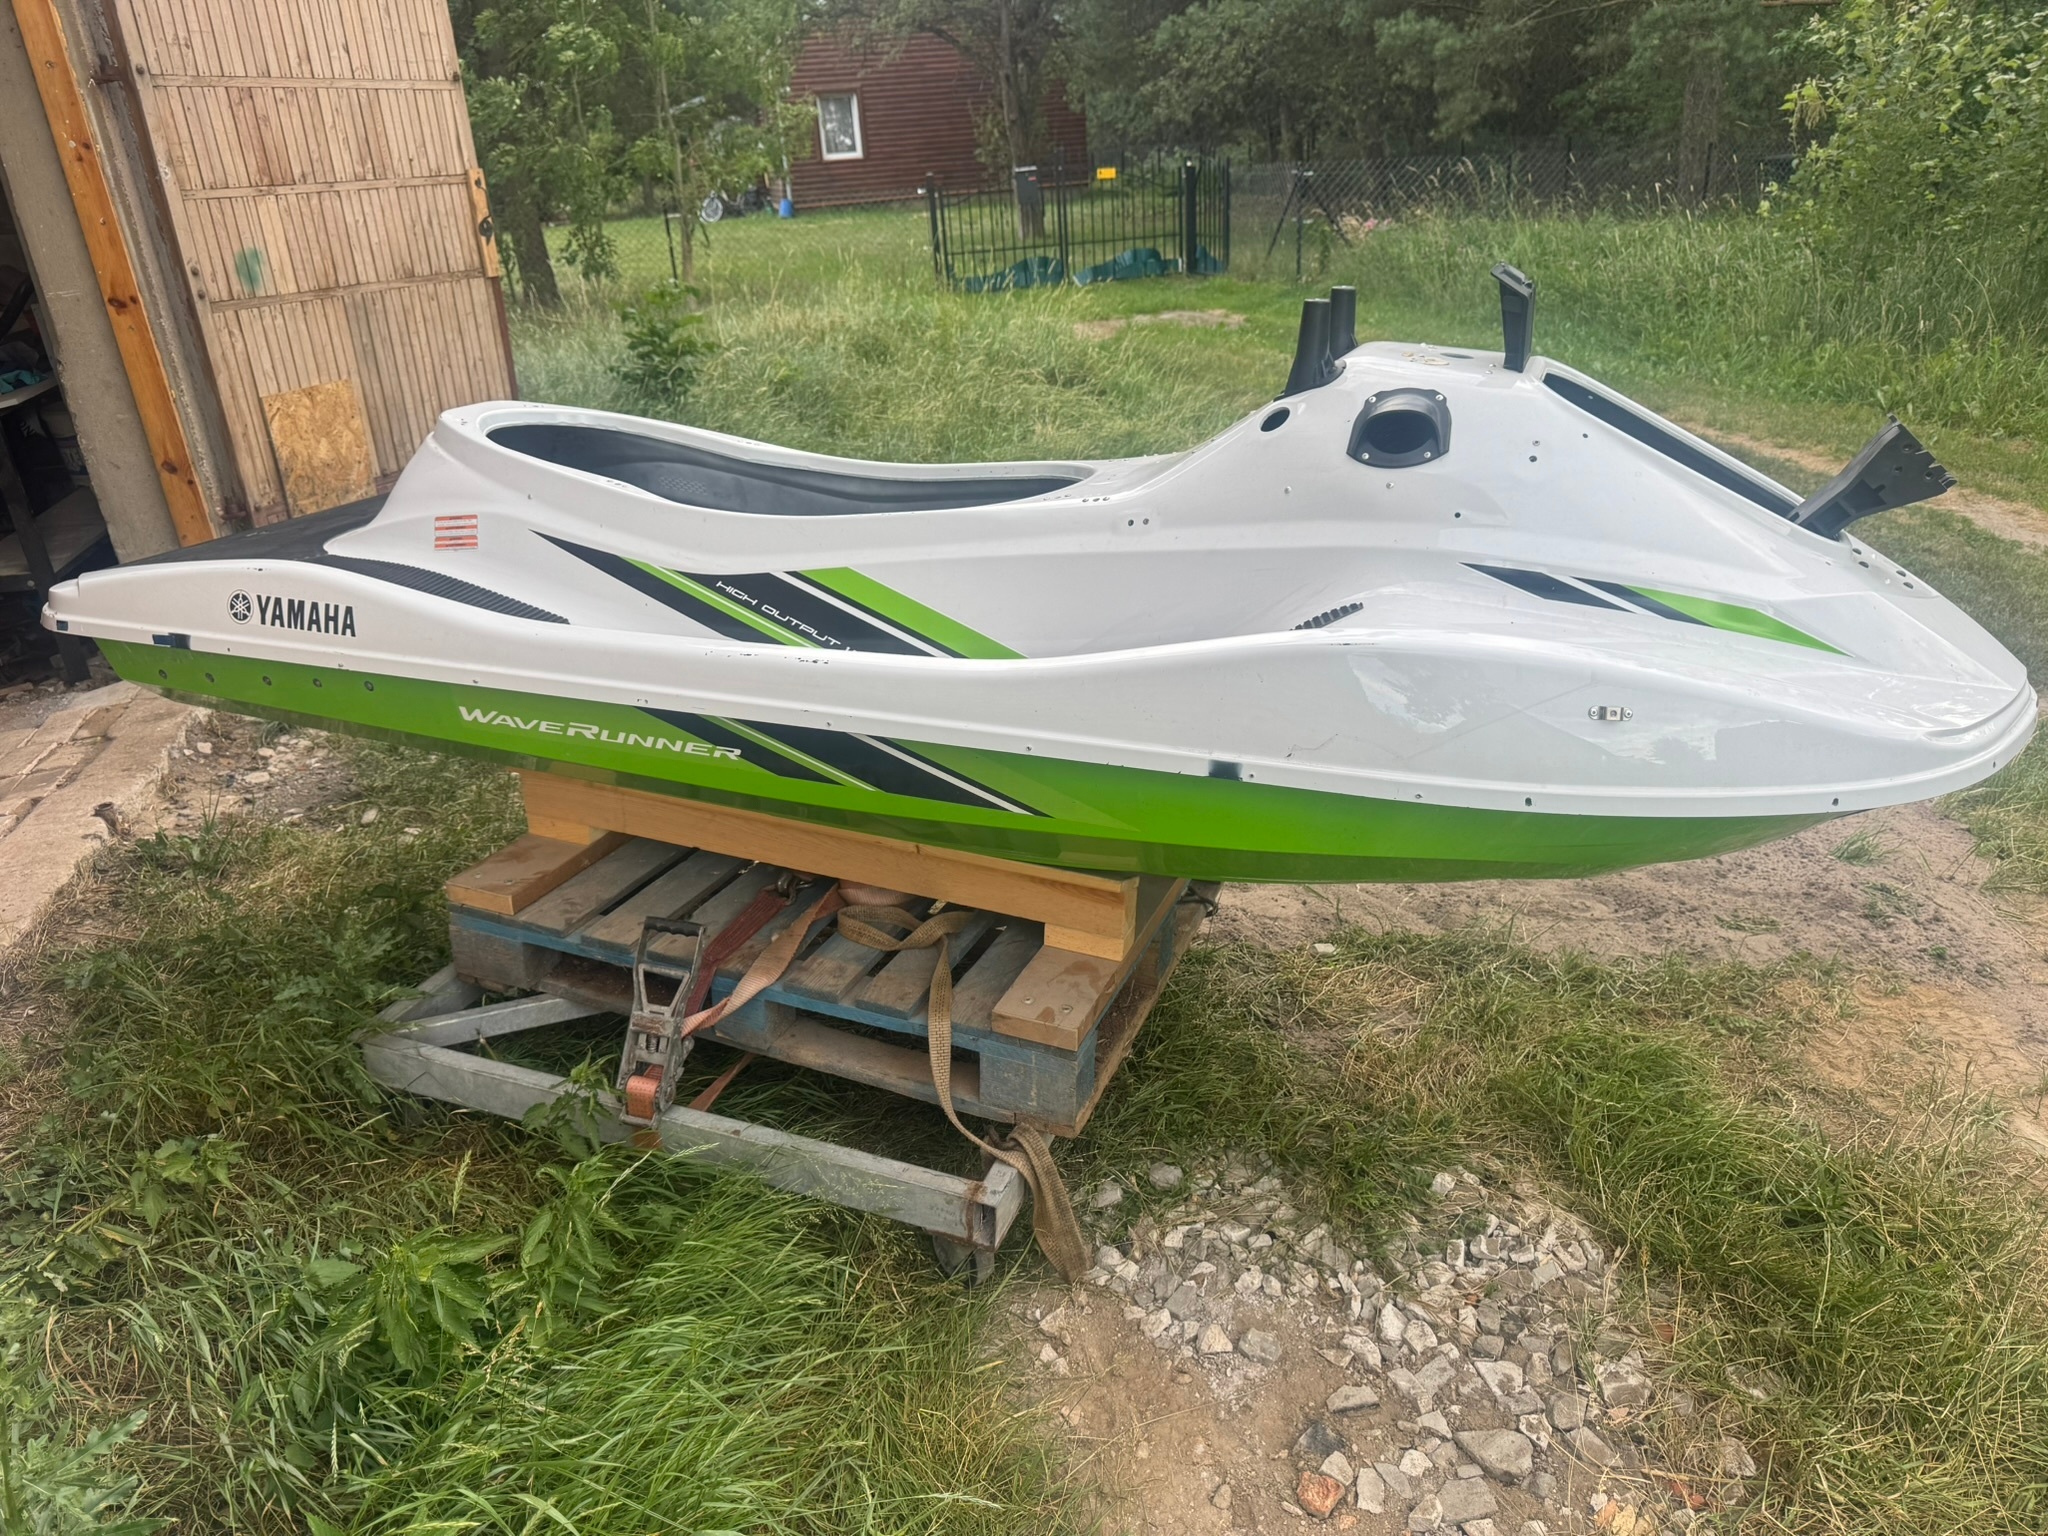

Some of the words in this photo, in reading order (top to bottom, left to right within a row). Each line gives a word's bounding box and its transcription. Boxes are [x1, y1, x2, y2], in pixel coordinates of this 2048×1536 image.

[256, 594, 356, 637] YAMAHA
[716, 581, 758, 605] HIGH
[761, 604, 841, 646] OUTPUT
